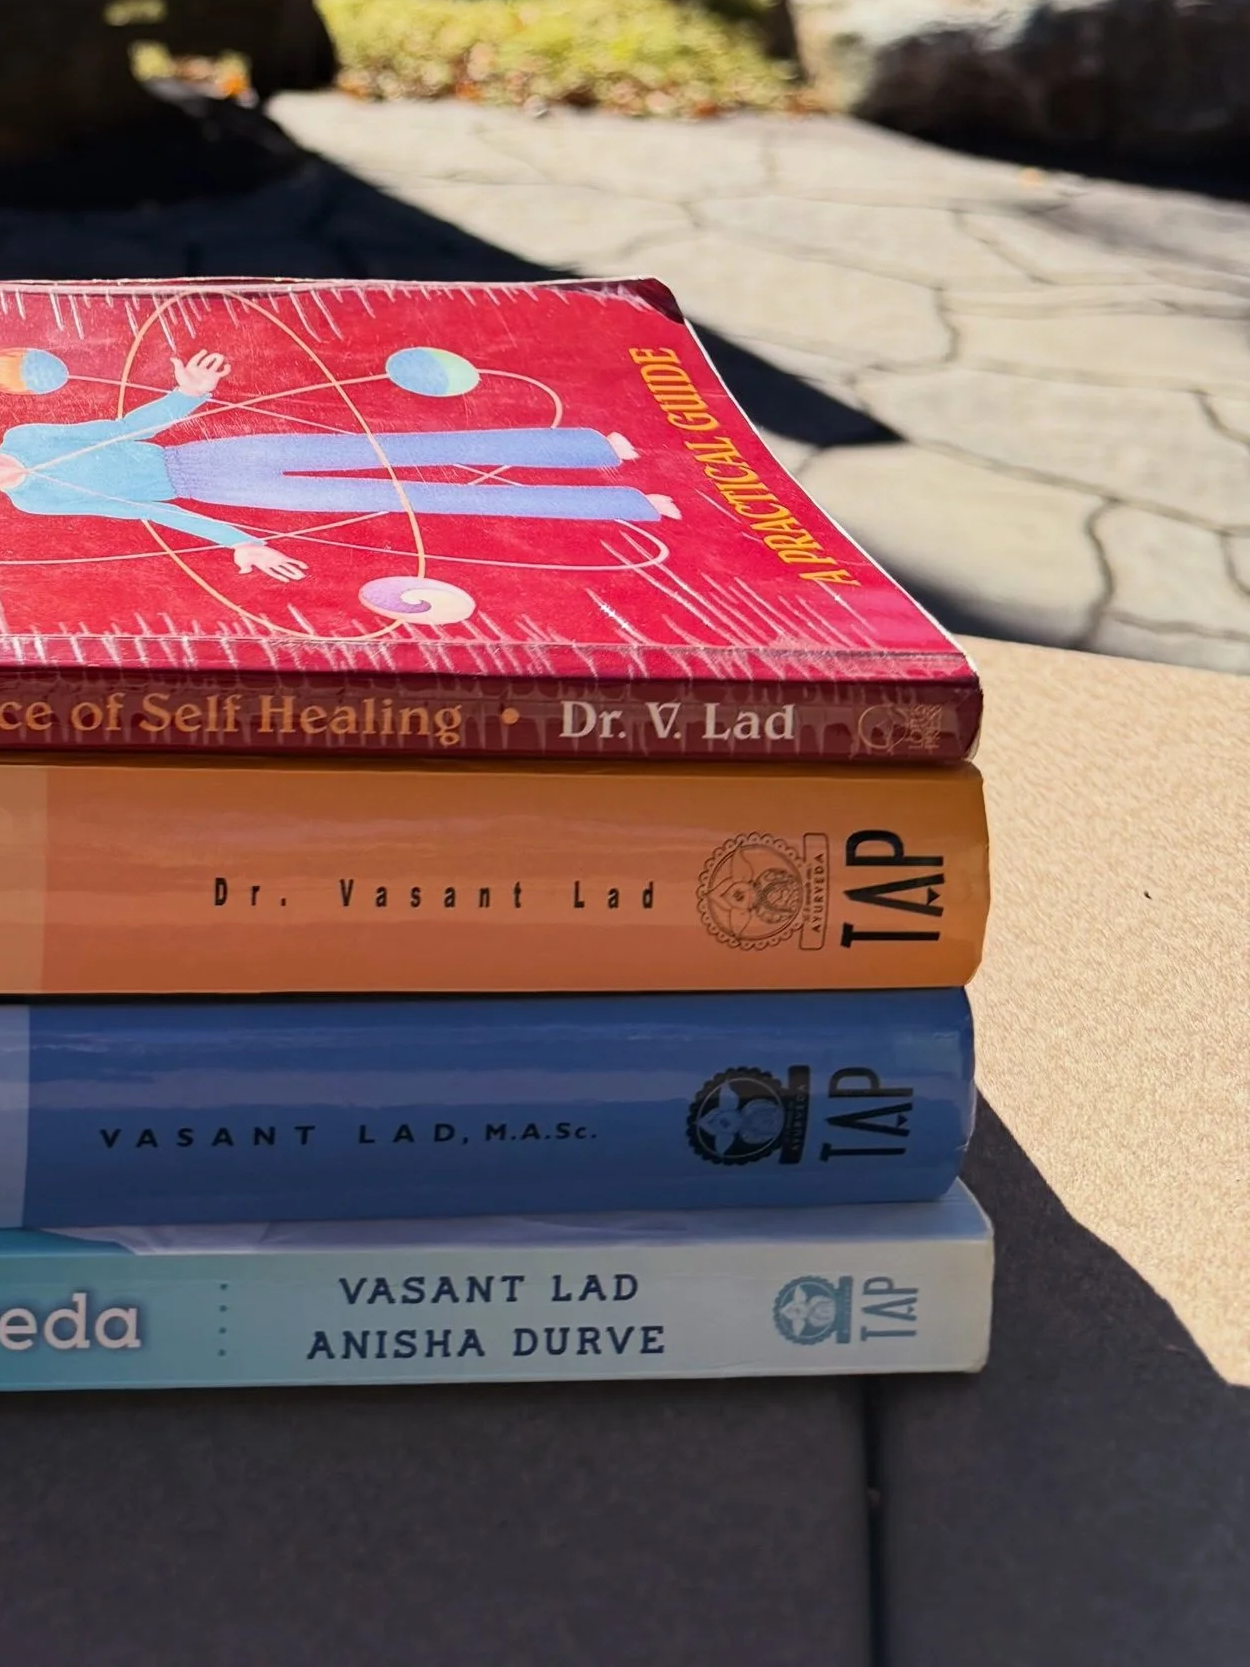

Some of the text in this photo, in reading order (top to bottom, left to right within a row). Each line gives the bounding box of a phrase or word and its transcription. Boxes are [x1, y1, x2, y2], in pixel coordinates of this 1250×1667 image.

[628, 346, 862, 588] A PRACTICAL GUIDE
[71, 692, 125, 733] of
[139, 692, 242, 733] Self
[257, 693, 463, 746] Healing
[559, 700, 796, 741] Dr. V. Lad
[213, 876, 658, 911] Dr. Vasant Lad
[840, 829, 945, 949] TAP
[99, 1120, 599, 1151] VASANT LAD, M.A.Sc.
[818, 1066, 915, 1163] TAP
[338, 1273, 640, 1306] VASANT LAD
[859, 1276, 920, 1342] TAP
[306, 1325, 666, 1362] ANISHA DURVE
